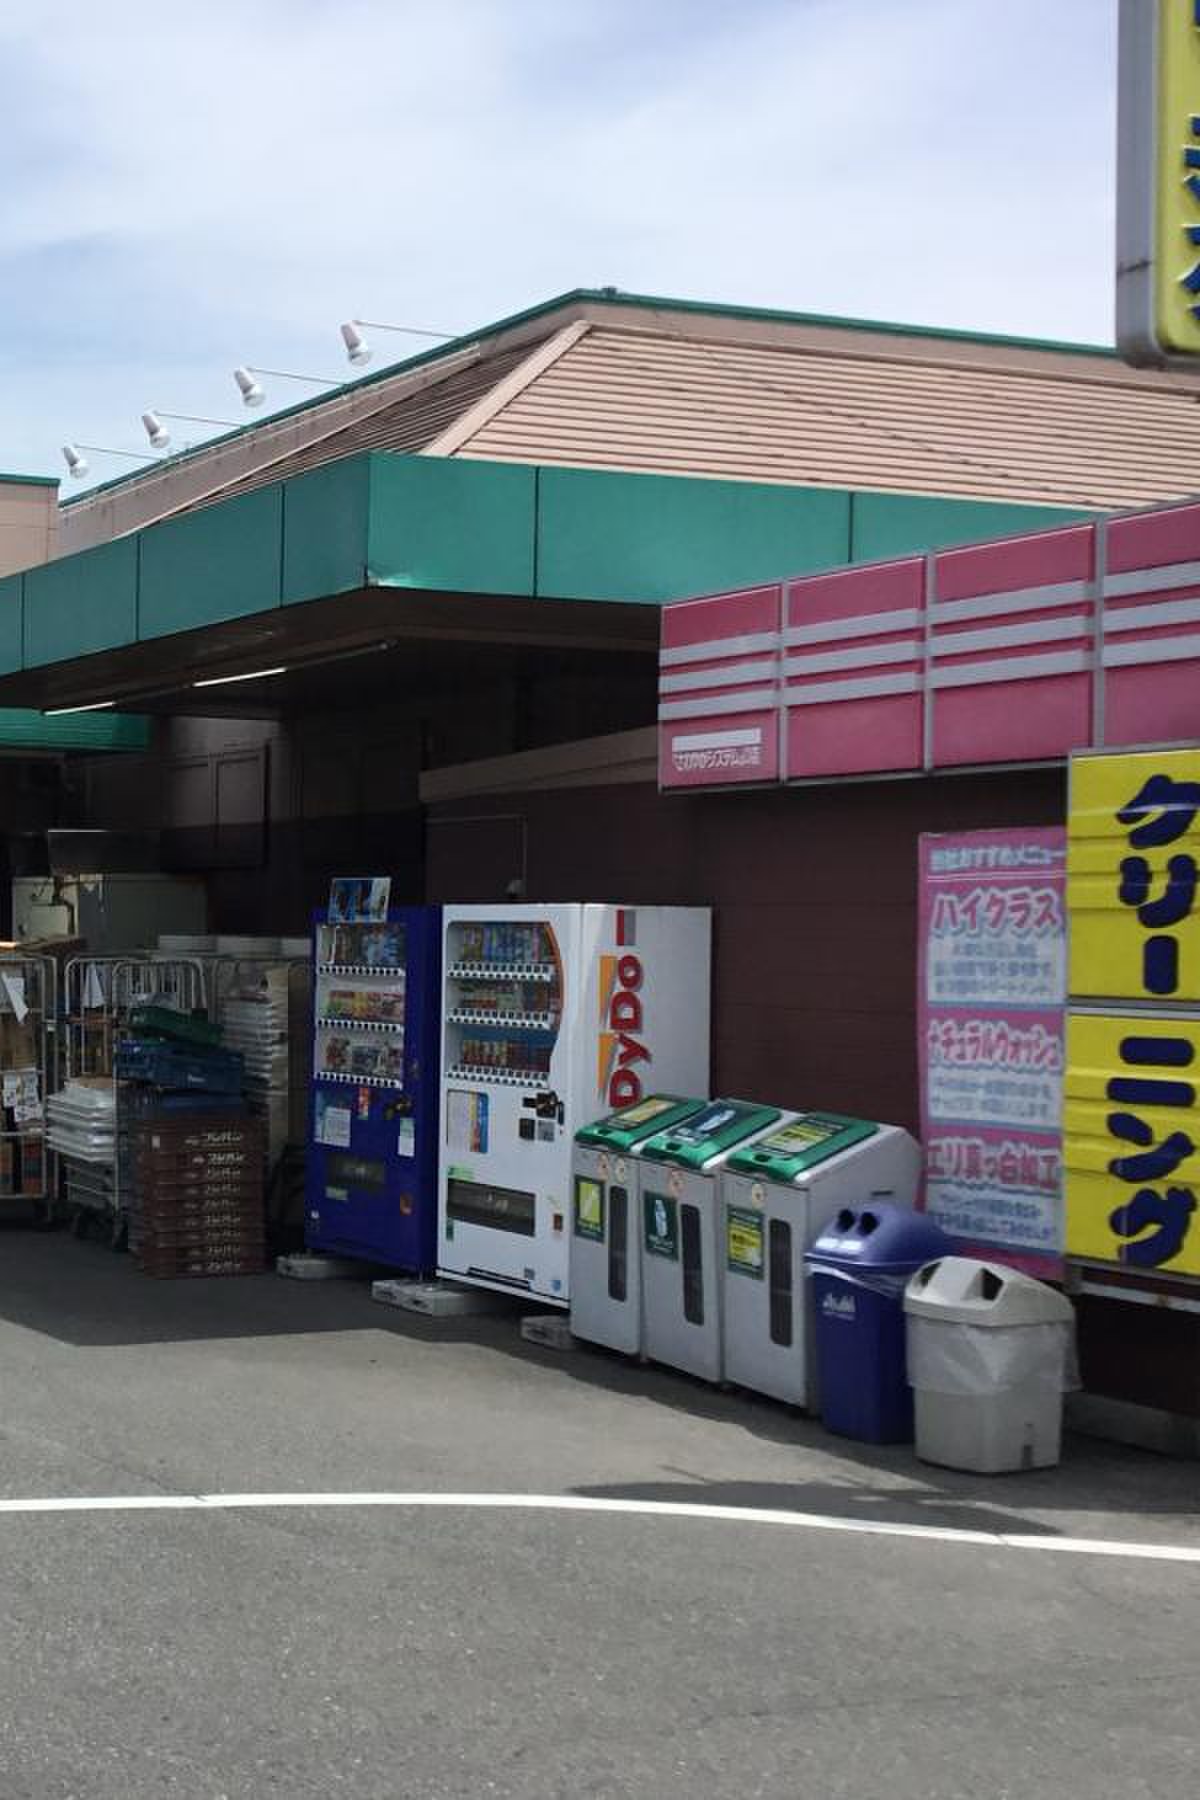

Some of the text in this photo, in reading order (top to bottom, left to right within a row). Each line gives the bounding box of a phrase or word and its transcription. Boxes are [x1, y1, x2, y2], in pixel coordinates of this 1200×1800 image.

[932, 887, 1058, 934] ハイクラス
[609, 954, 652, 1109] DyDo
